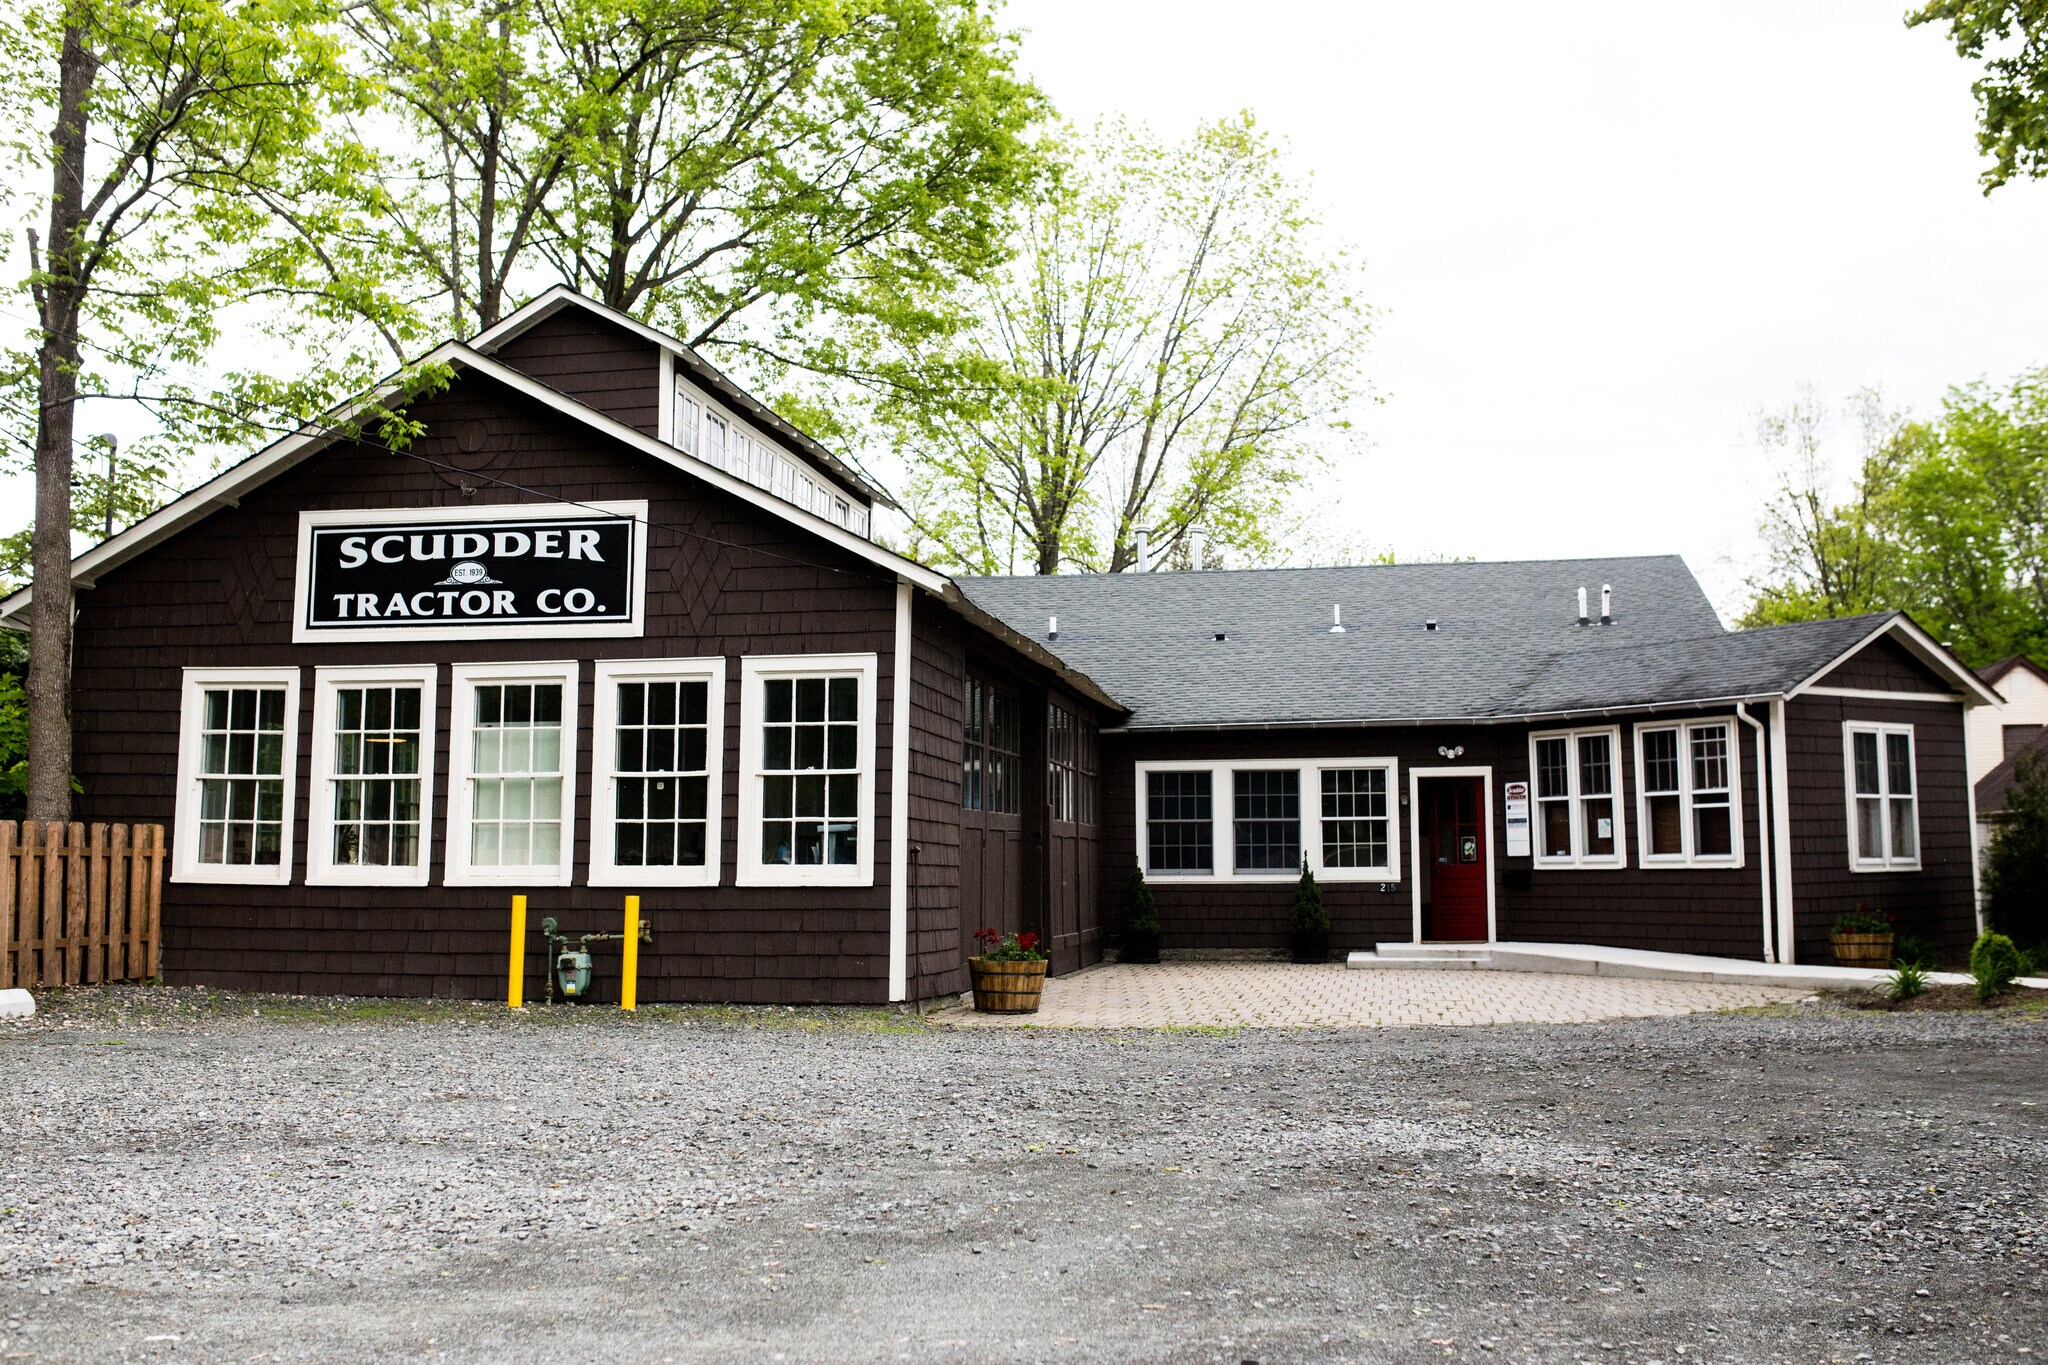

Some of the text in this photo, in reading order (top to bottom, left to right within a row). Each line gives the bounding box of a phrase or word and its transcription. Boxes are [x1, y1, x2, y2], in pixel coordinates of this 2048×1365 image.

[339, 529, 605, 569] SCUDDER
[454, 568, 483, 577] EST. 1939
[333, 588, 607, 618] TRACTOR CO.
[1380, 883, 1396, 892] 215
